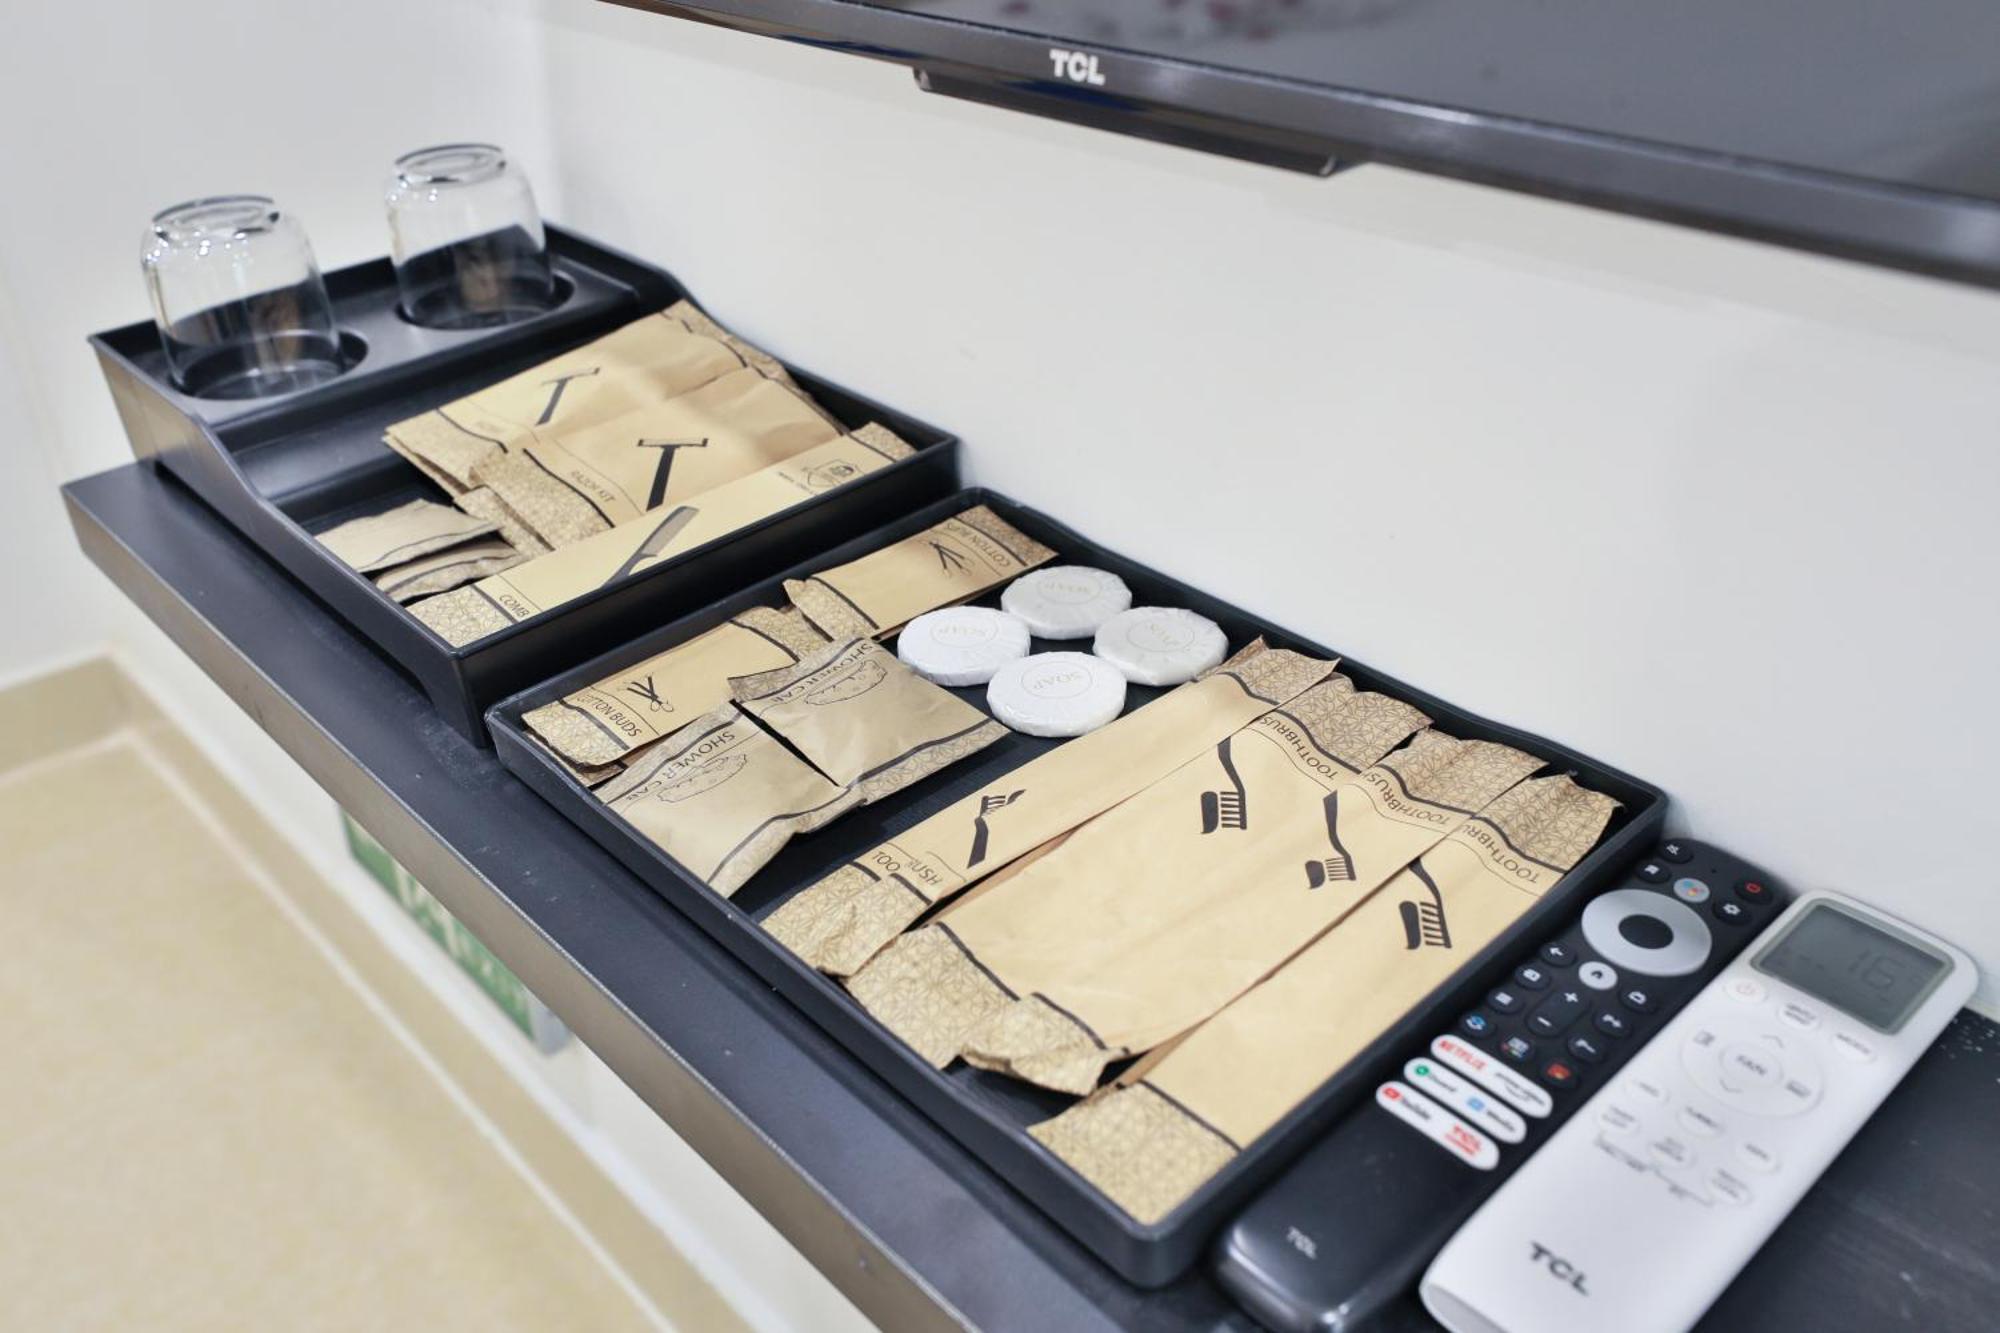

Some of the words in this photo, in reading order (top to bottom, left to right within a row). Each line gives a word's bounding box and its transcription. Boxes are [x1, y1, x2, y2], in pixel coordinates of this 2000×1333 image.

[1049, 48, 1106, 86] TCL
[499, 594, 530, 617] COMB
[609, 712, 642, 737] BUDS
[661, 730, 735, 780] SHOWER
[1362, 769, 1450, 825] TOOTHBRUS
[1287, 1226, 1317, 1259] TCL
[1530, 1240, 1590, 1297] TCL
